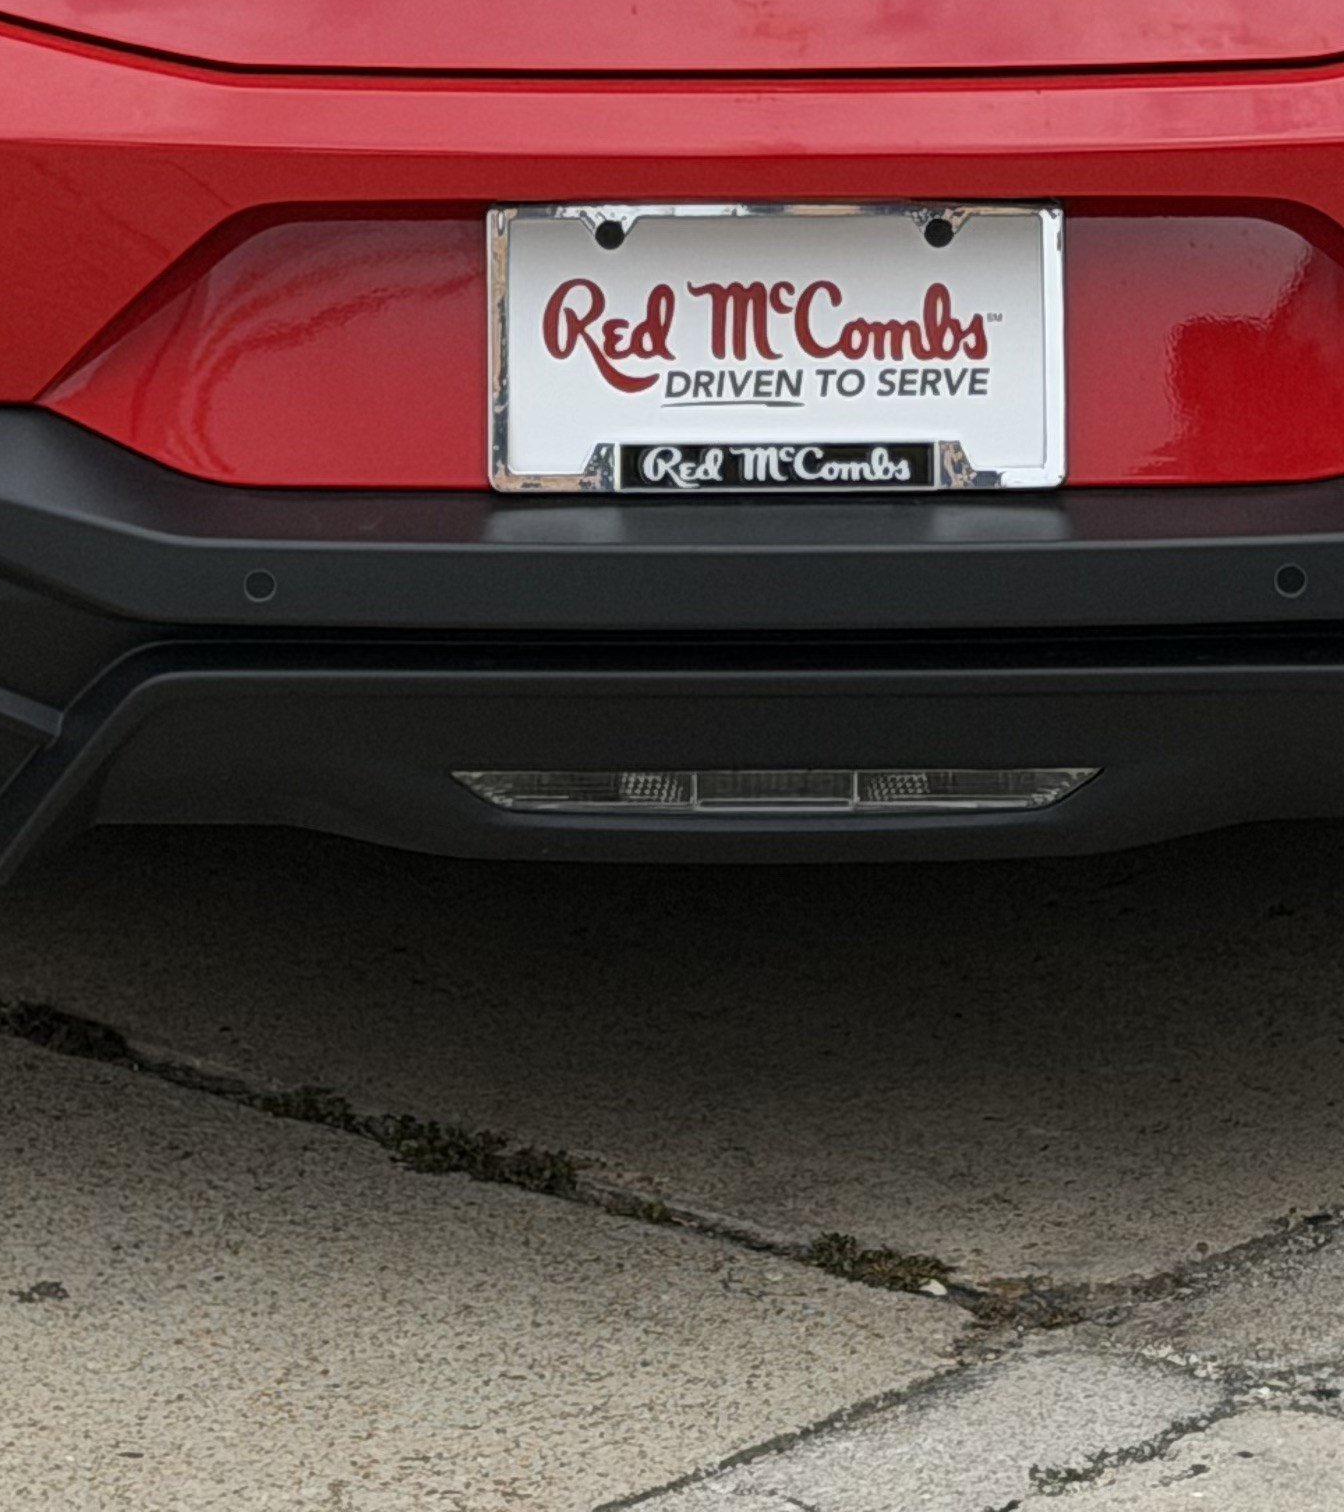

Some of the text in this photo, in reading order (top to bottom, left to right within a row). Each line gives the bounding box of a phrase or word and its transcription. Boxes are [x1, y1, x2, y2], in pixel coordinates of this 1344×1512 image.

[543, 278, 676, 393] Red
[664, 368, 990, 398] DRIVEN TO SERVE
[643, 447, 723, 487] Red
